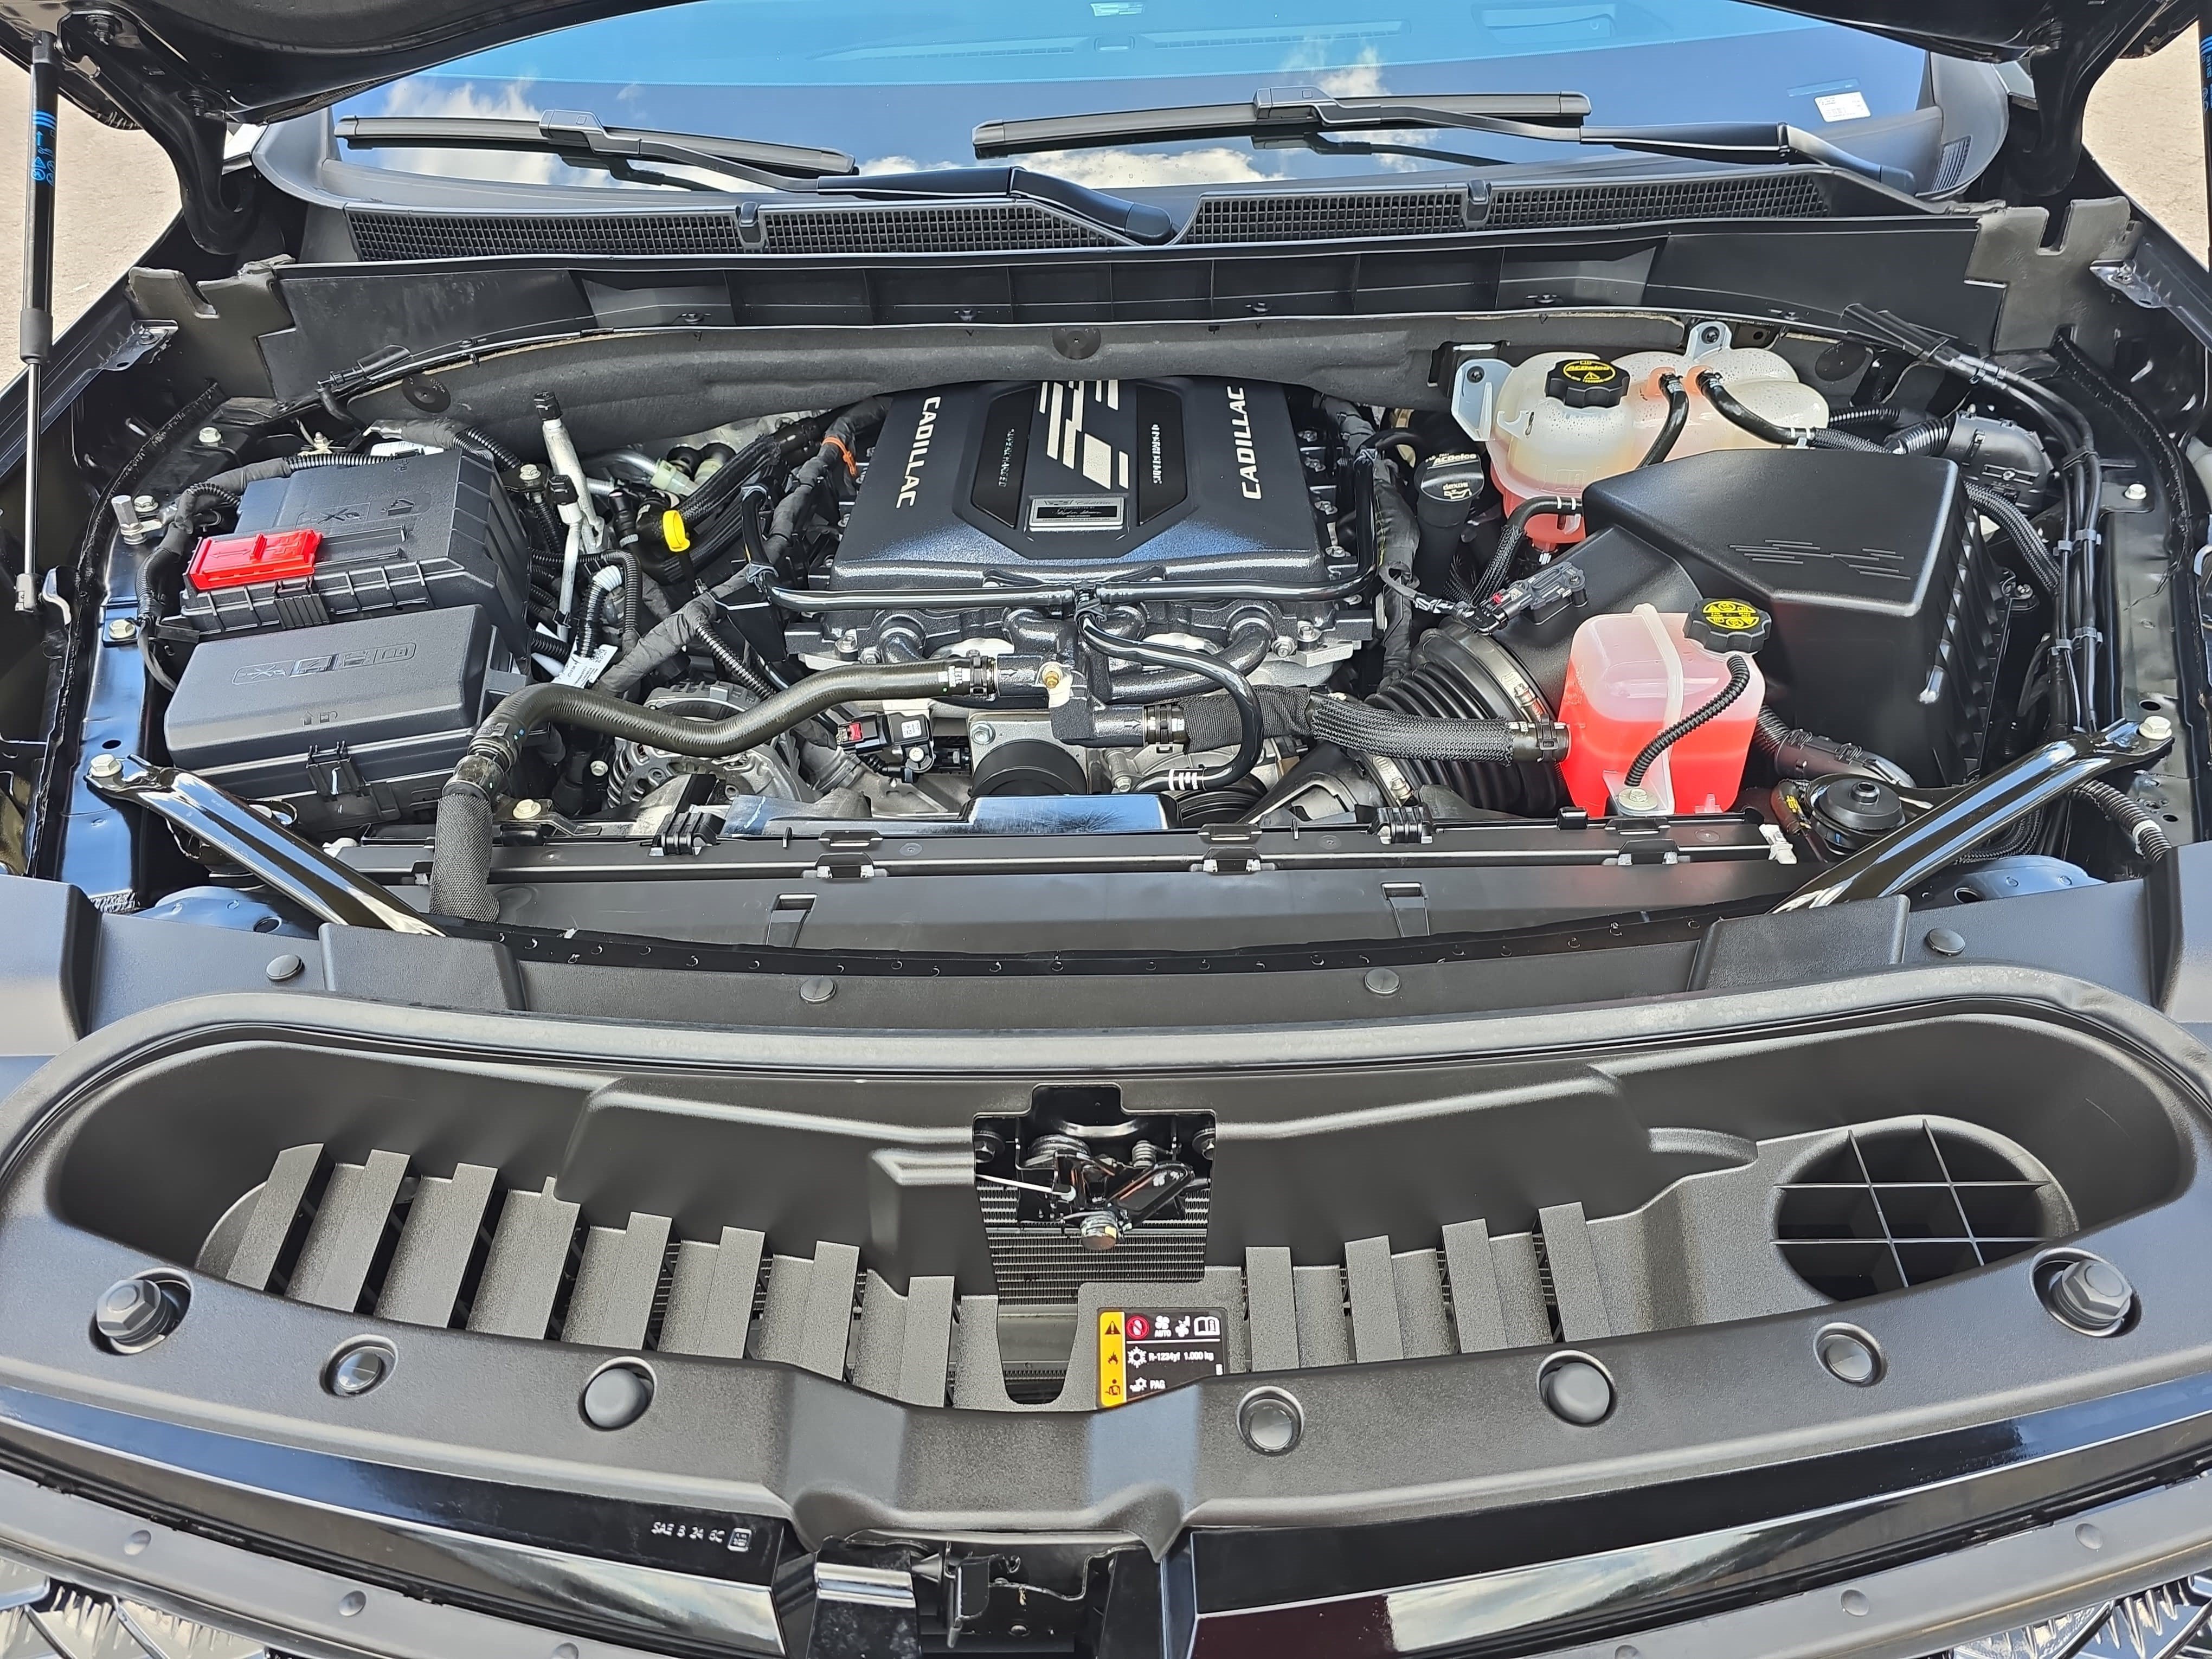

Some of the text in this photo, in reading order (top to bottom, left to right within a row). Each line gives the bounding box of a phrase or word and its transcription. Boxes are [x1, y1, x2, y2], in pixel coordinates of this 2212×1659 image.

[1226, 385, 1262, 499] CADILLAC
[896, 396, 941, 509] CADILLAC
[1432, 453, 1477, 467] ACDelco
[1443, 482, 1469, 491] dexos
[1154, 1329, 1172, 1338] AUTO
[1148, 1351, 1214, 1362] R-1234yf 1.000 kg
[1149, 1380, 1166, 1390] PAG
[651, 1521, 674, 1536] SAE
[689, 1526, 704, 1540] 24
